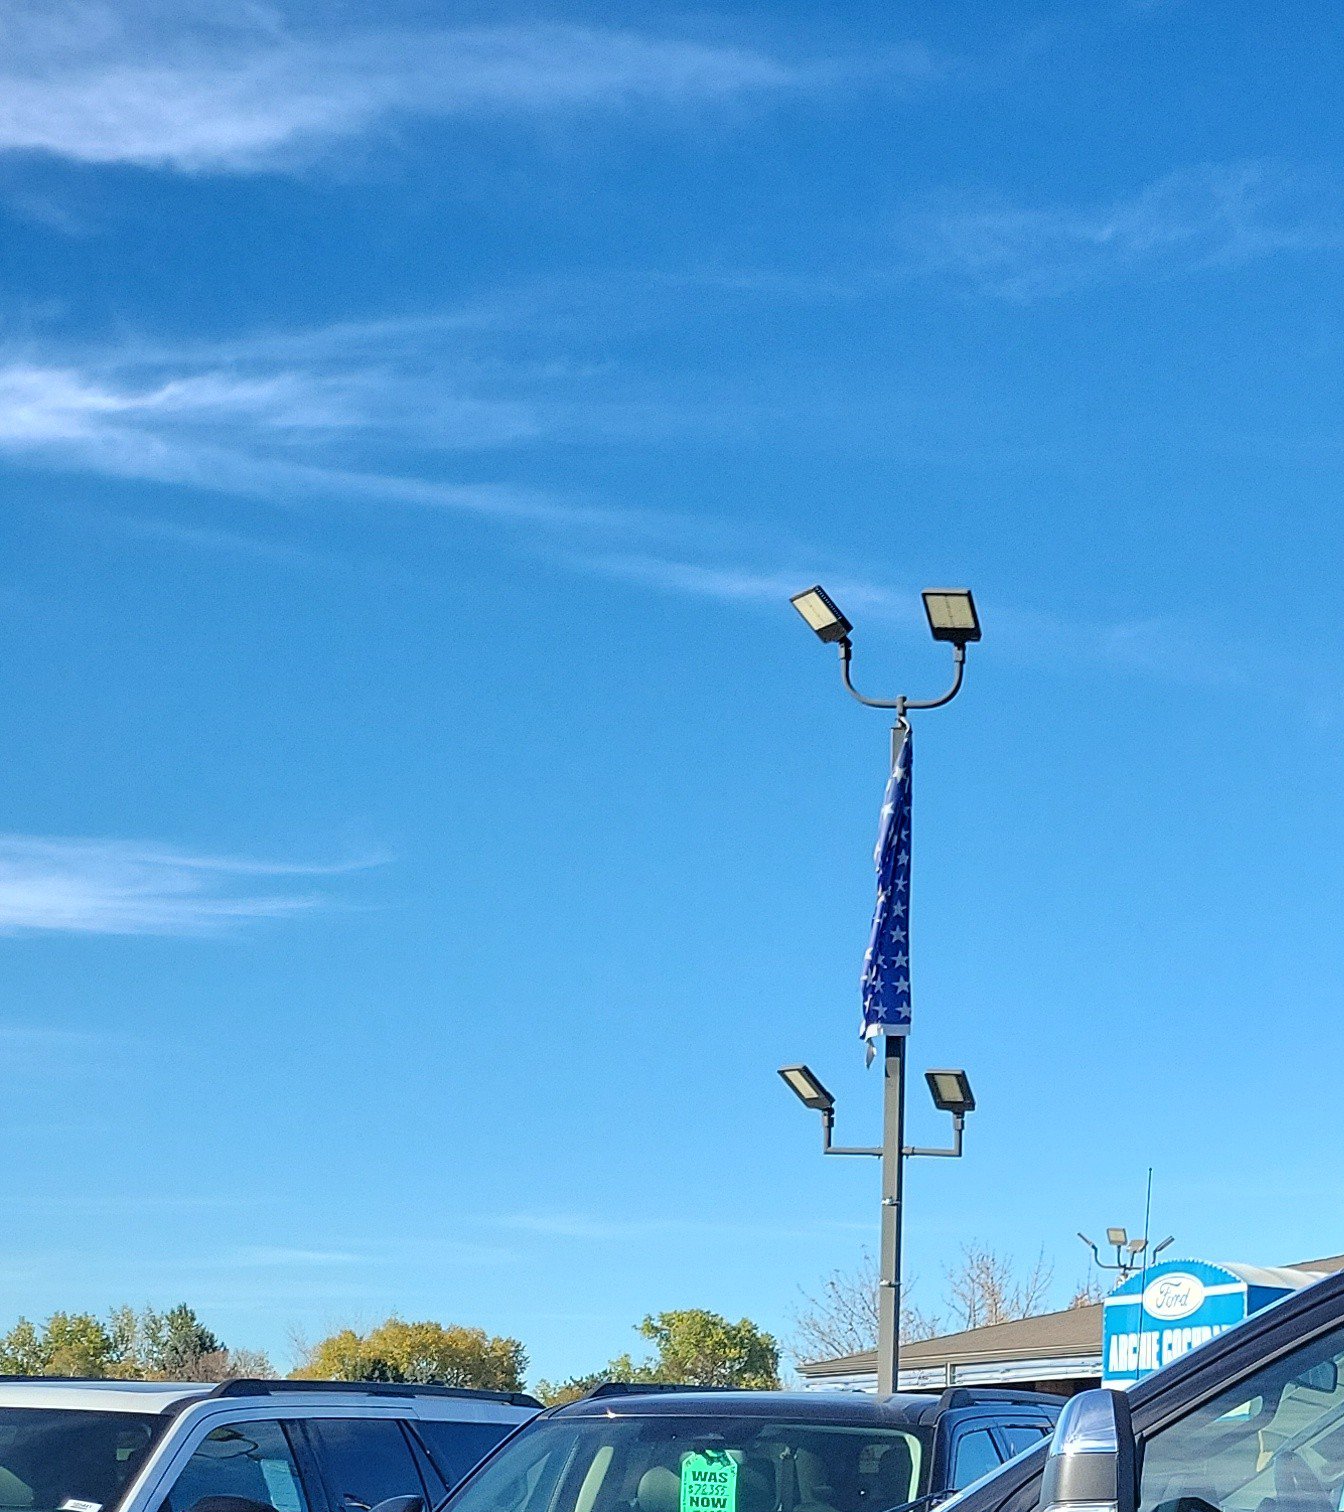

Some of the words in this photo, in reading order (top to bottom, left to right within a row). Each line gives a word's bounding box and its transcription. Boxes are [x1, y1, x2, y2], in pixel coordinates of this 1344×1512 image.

[1155, 1281, 1191, 1309] Ford
[1109, 1330, 1160, 1372] ARCHIE
[691, 1470, 728, 1483] WAS
[689, 1496, 728, 1509] NOW
